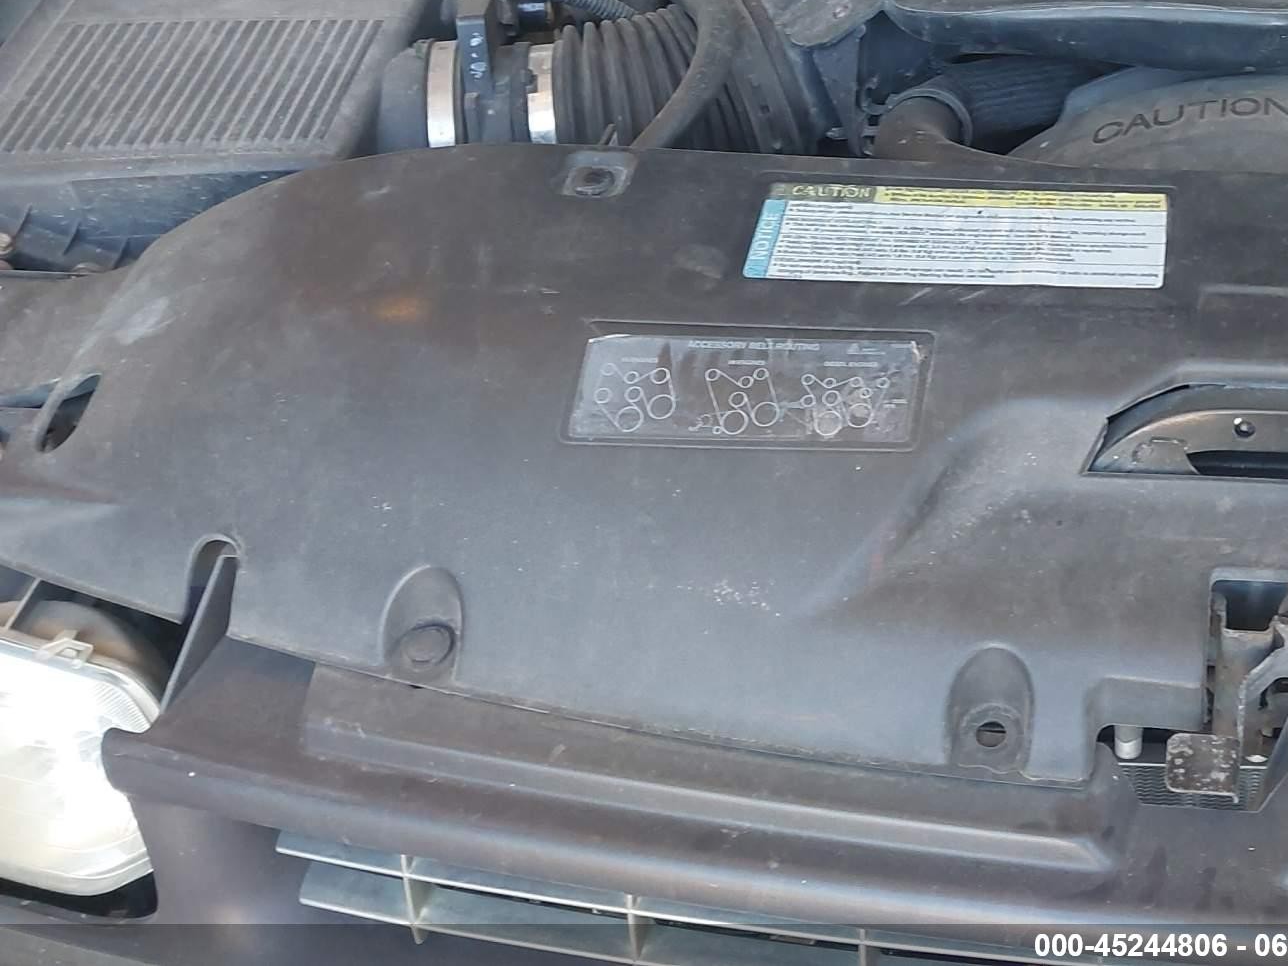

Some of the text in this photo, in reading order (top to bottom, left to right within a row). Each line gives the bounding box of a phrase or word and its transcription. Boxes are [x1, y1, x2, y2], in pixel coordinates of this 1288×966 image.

[792, 185, 871, 198] CAUTION
[751, 213, 778, 260] NOTICE
[688, 339, 746, 349] ACCESSORY
